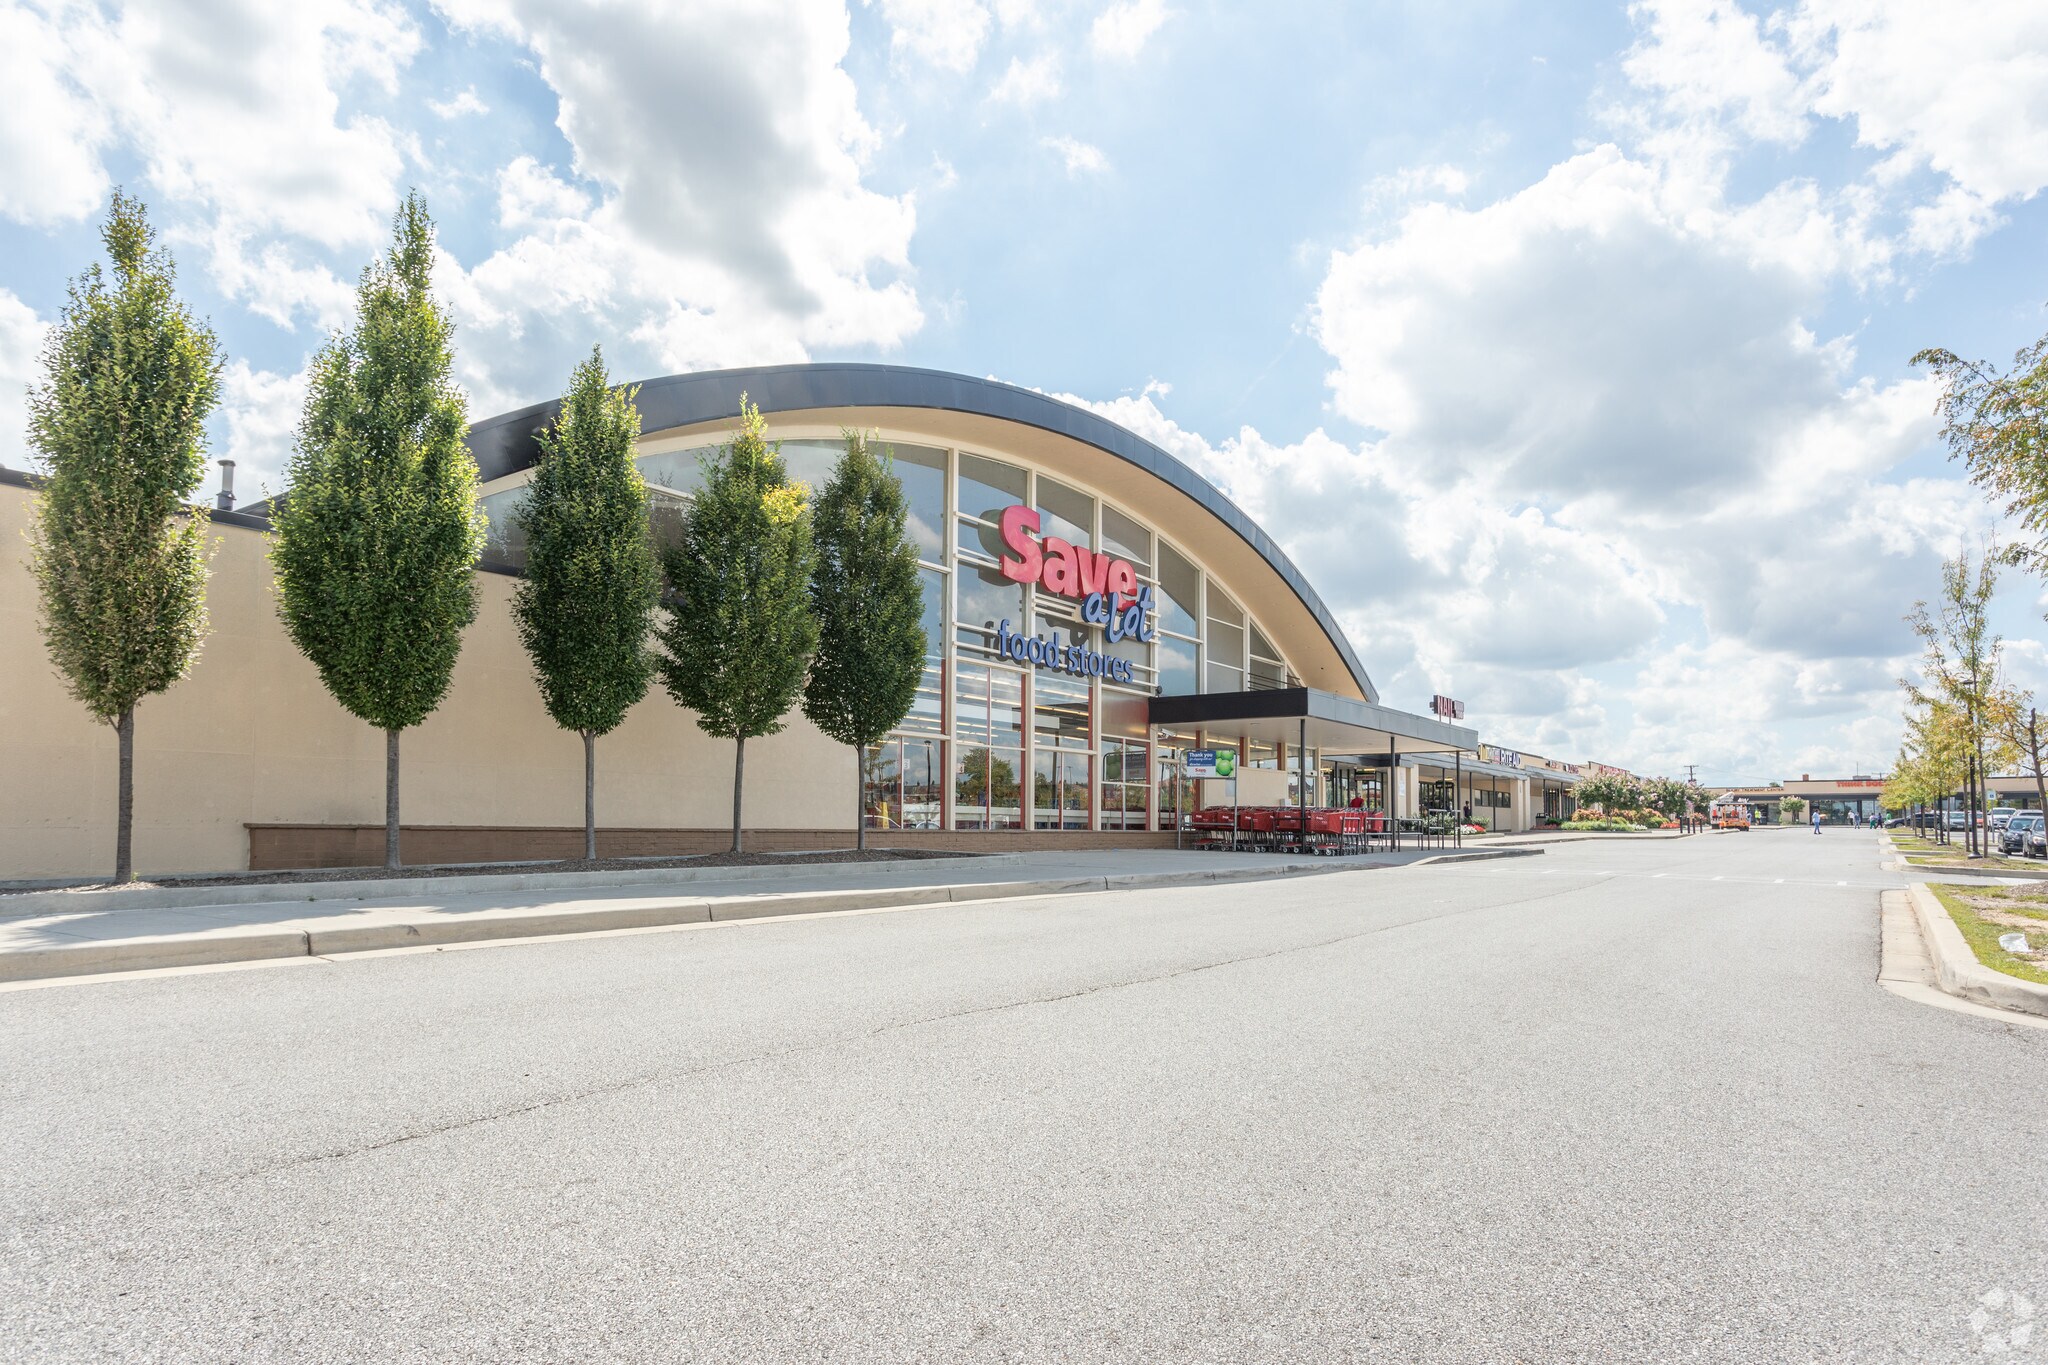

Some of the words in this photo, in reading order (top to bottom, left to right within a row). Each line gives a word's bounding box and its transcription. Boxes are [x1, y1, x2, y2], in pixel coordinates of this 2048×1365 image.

[999, 505, 1137, 612] Save
[998, 618, 1059, 668] food
[1067, 644, 1134, 684] stores
[1500, 749, 1511, 766] RITE
